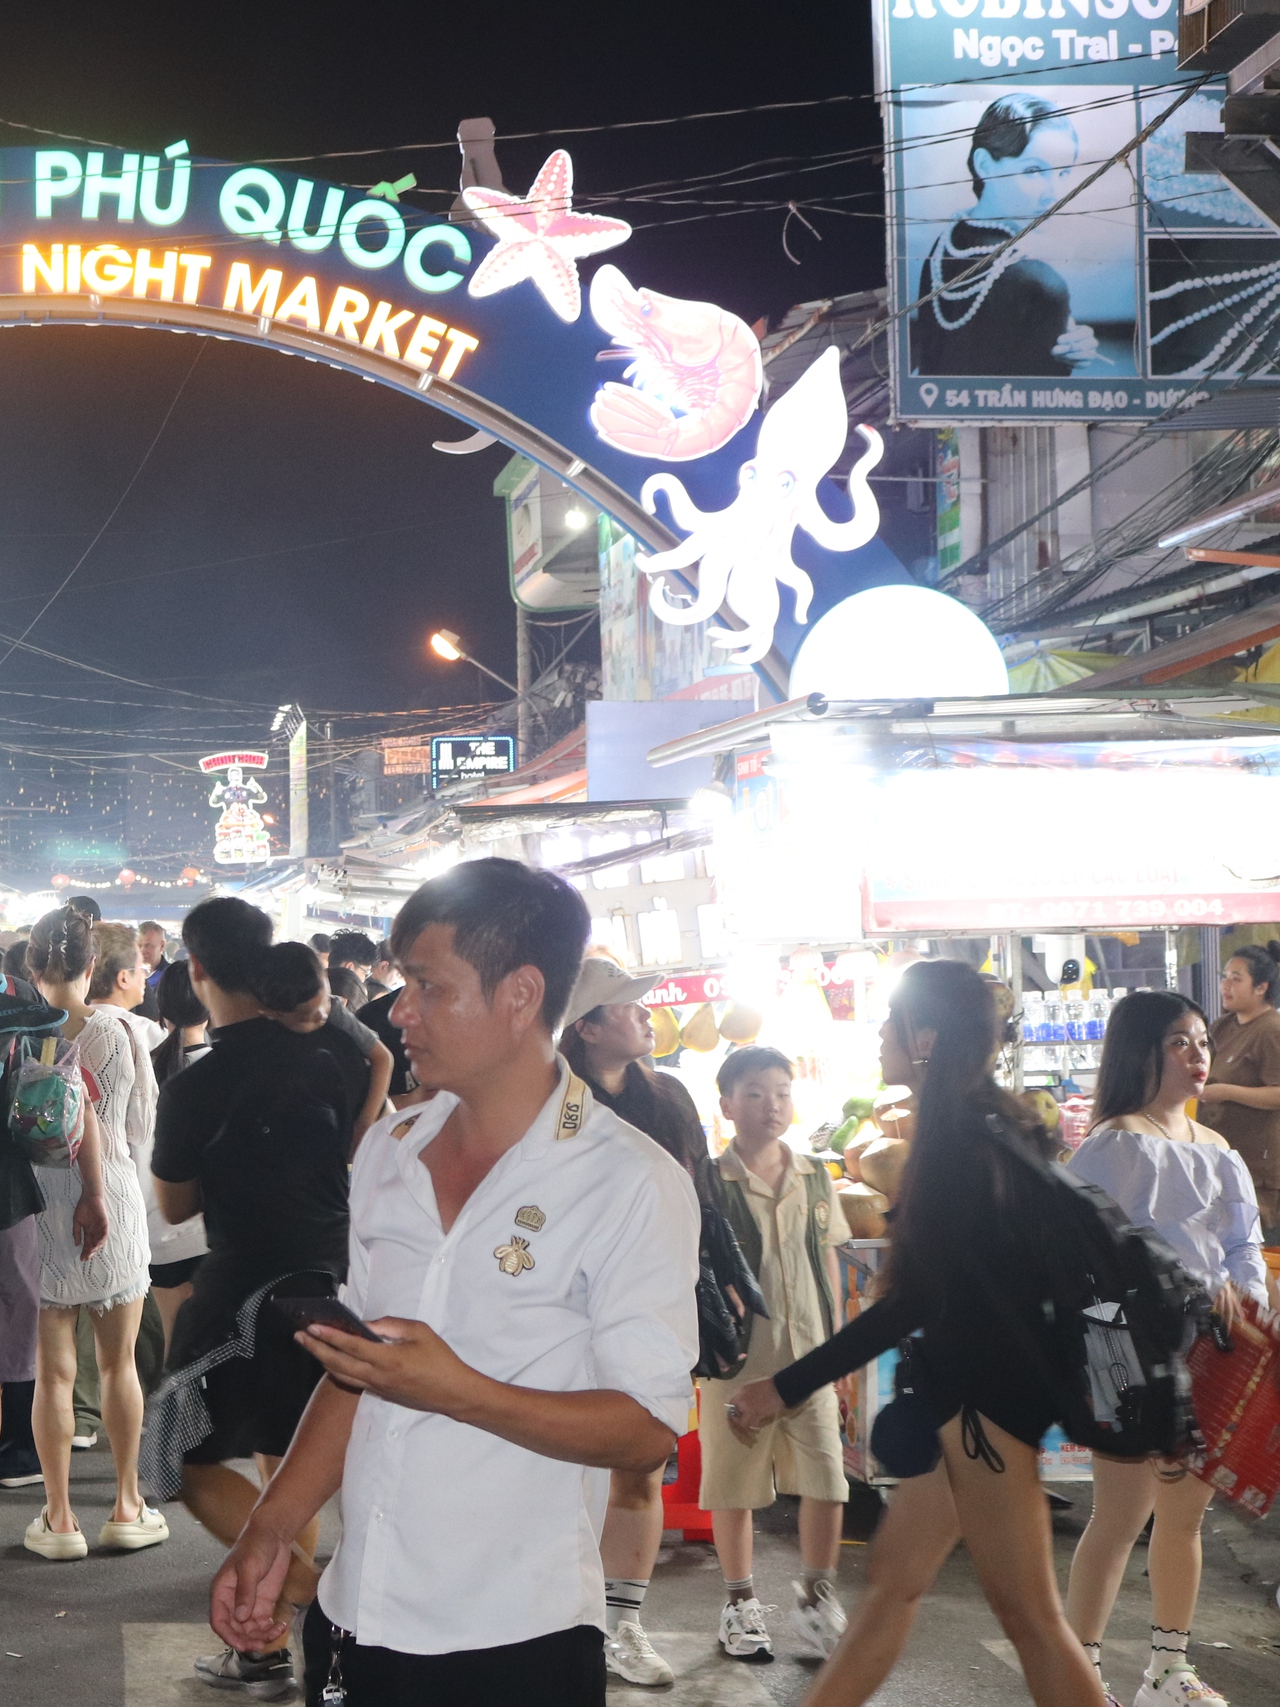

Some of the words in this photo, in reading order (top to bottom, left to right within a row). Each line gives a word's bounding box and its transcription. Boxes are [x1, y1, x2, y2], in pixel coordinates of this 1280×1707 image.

[952, 28, 1044, 67] Ngọc
[35, 139, 191, 227] PHÚ
[219, 172, 473, 293] QUỐC
[22, 243, 212, 305] NIGHT
[223, 261, 480, 381] MARKET
[934, 390, 971, 408] 54
[974, 383, 1027, 408] TRẦN
[1032, 388, 1084, 408] HƯNG
[1088, 390, 1129, 411] ĐẠO
[468, 741, 496, 755] THE
[456, 756, 509, 770] EMPIRE
[1039, 901, 1104, 920] 0971
[1115, 900, 1165, 919] 739
[1172, 898, 1225, 918] 004
